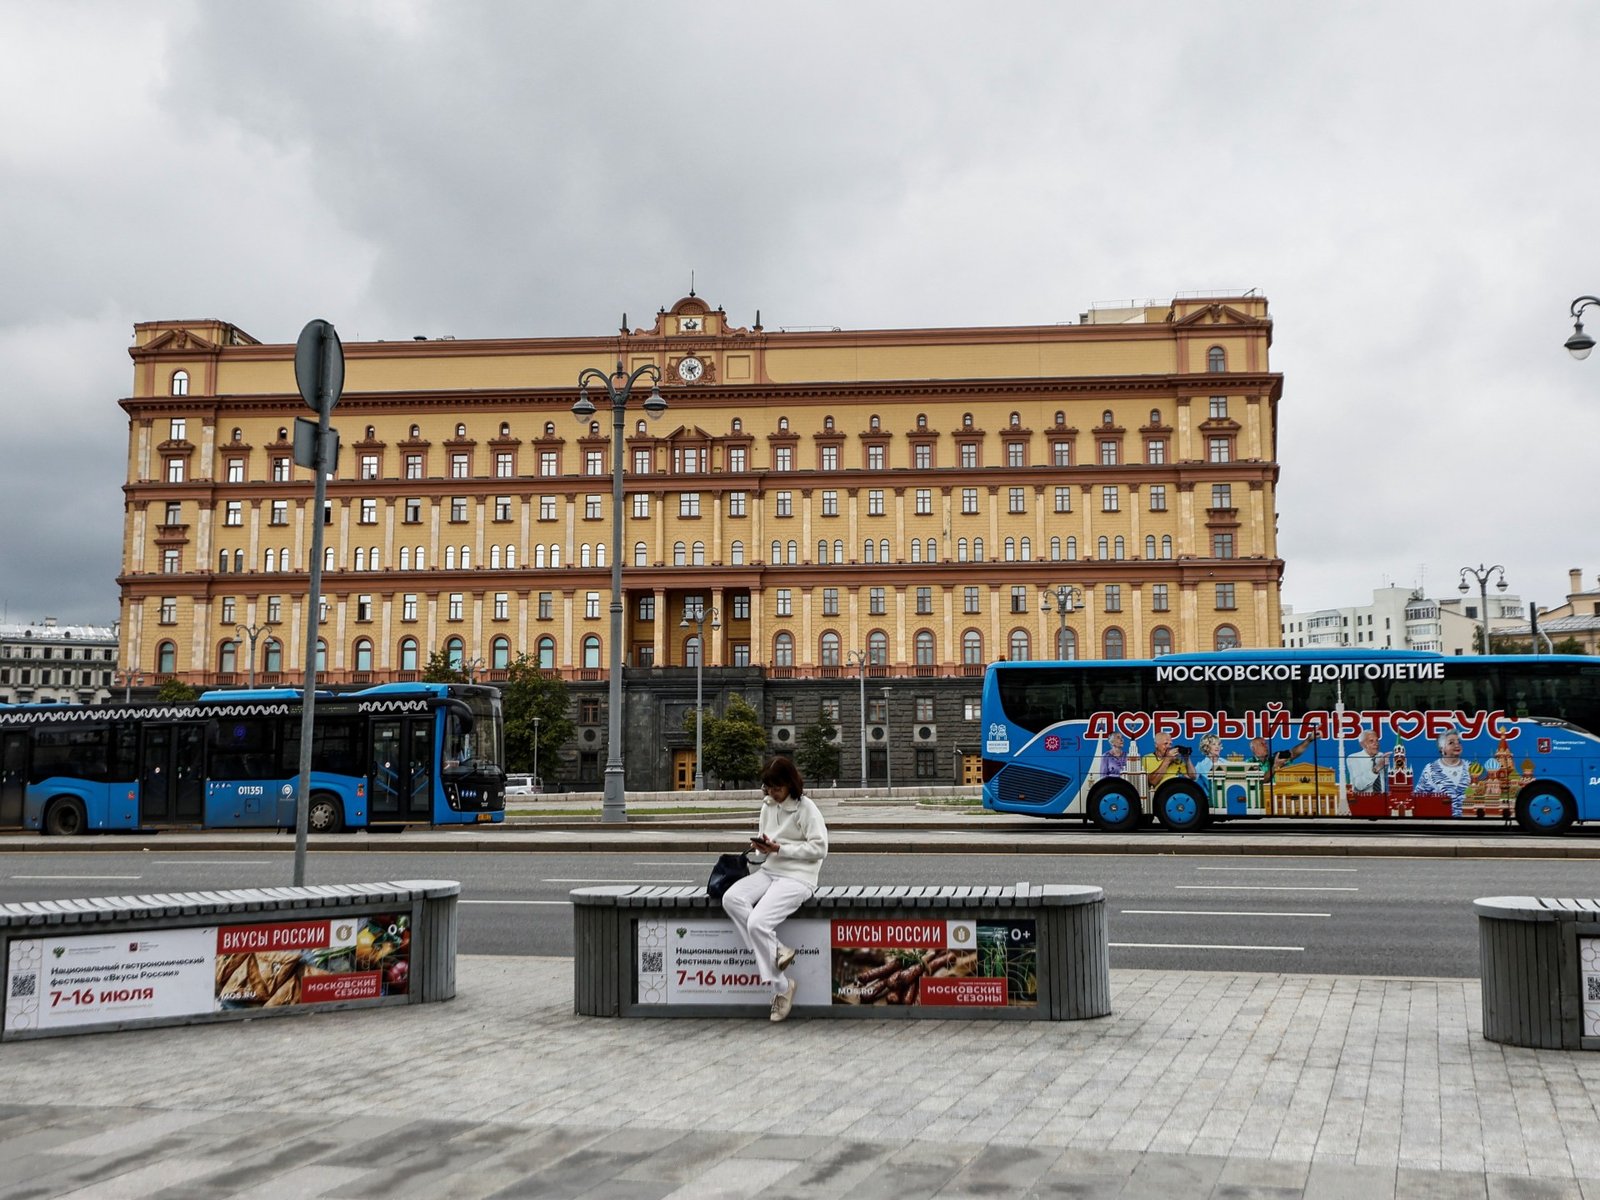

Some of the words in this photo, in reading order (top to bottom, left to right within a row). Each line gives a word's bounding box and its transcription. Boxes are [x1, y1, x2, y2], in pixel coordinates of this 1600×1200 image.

[1156, 665, 1301, 681] МОСКОВСКОЕ
[1308, 663, 1445, 683] ДОЛГОЛЕТИЕ
[1083, 702, 1291, 740] ДОБРЫЙ
[1298, 710, 1521, 741] АВТОБУС
[238, 786, 263, 795] 011351
[223, 932, 268, 949] ВКУСЫ
[273, 929, 325, 945] РОССИИ
[837, 925, 882, 942] ВКУСЫ
[887, 925, 941, 942] РОССИИ
[1011, 928, 1031, 941] 0+
[675, 947, 738, 956] Национальный
[51, 964, 120, 976] Национальный
[121, 956, 205, 970] гастрономический
[675, 957, 722, 966] фестиваль
[723, 957, 756, 966] «Вкусы
[50, 976, 101, 988] фестиваль
[103, 973, 138, 982] «Вкусы
[140, 970, 180, 980] России»
[308, 979, 376, 991] МОСКОВСКИЕ
[100, 987, 154, 1003] июля
[334, 987, 376, 998] СЕЗОНЫ
[927, 985, 1002, 994] МОСКОВСКИЕ
[956, 994, 1002, 1003] СЕЗОНЫ
